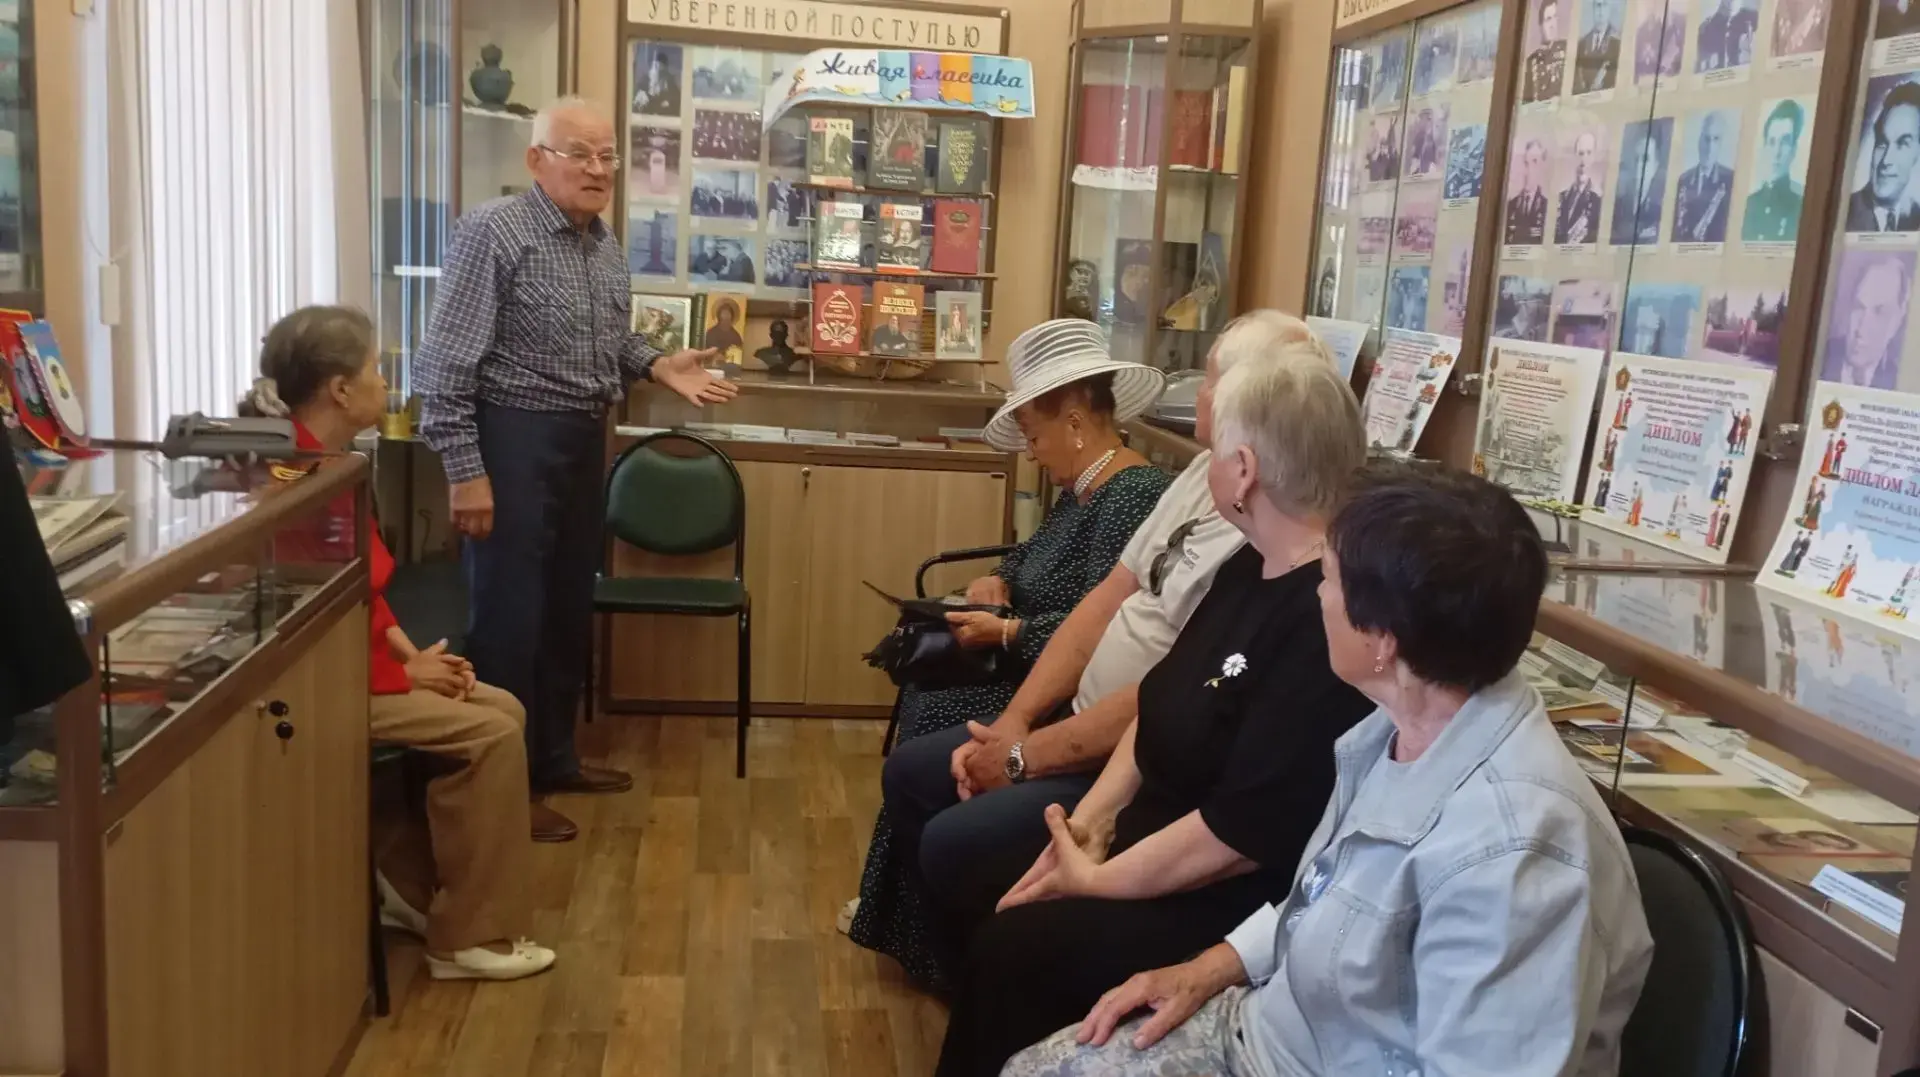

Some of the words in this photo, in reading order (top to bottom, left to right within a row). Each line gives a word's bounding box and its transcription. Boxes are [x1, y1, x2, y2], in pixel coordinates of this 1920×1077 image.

[648, 0, 820, 34] УВЕРЕННОЙ
[830, 13, 981, 49] ПОСТУПЬЮ
[816, 51, 908, 82] Живая
[912, 66, 1025, 89] классика
[1643, 423, 1703, 447] ДИПЛОМ
[1840, 466, 1903, 494] ДИПЛОМ
